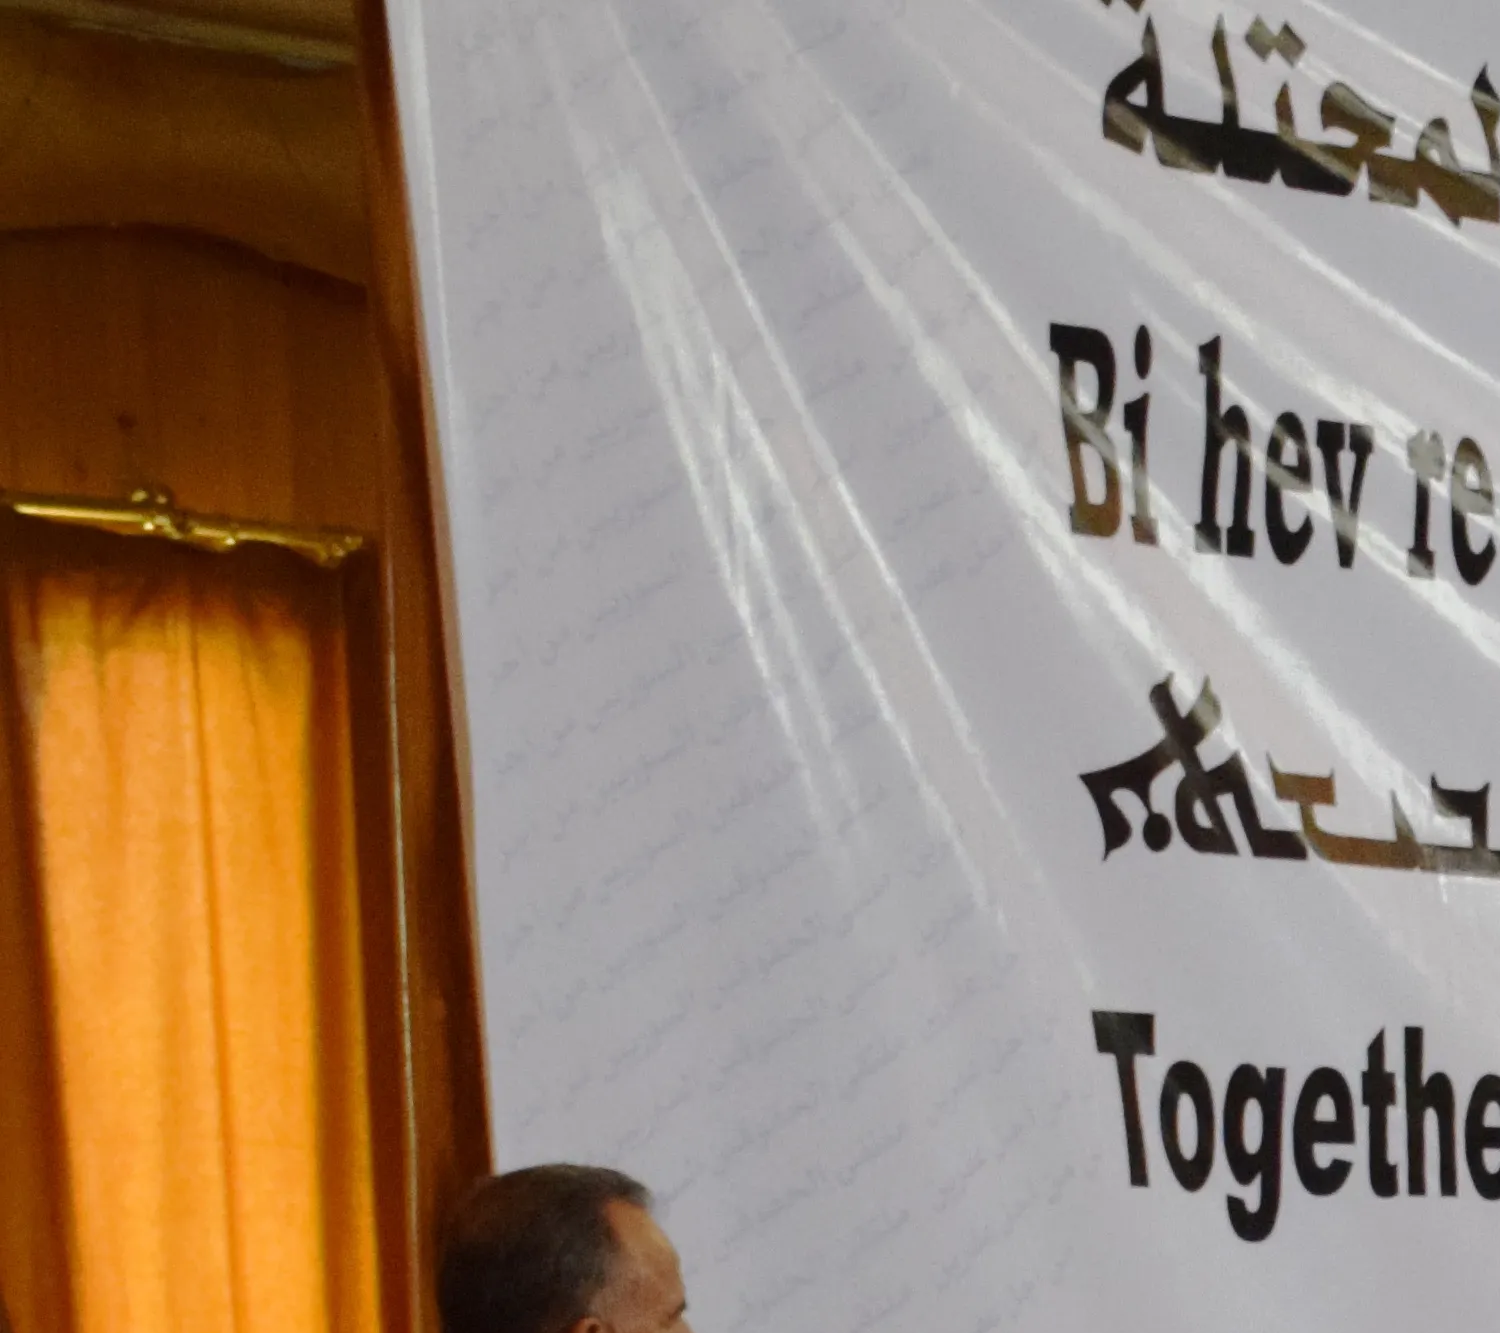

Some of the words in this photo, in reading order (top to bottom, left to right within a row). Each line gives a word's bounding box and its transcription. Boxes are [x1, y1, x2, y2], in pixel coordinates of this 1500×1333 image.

[1049, 321, 1158, 545] Bi
[1193, 333, 1376, 571] hev
[1405, 426, 1499, 587] re
